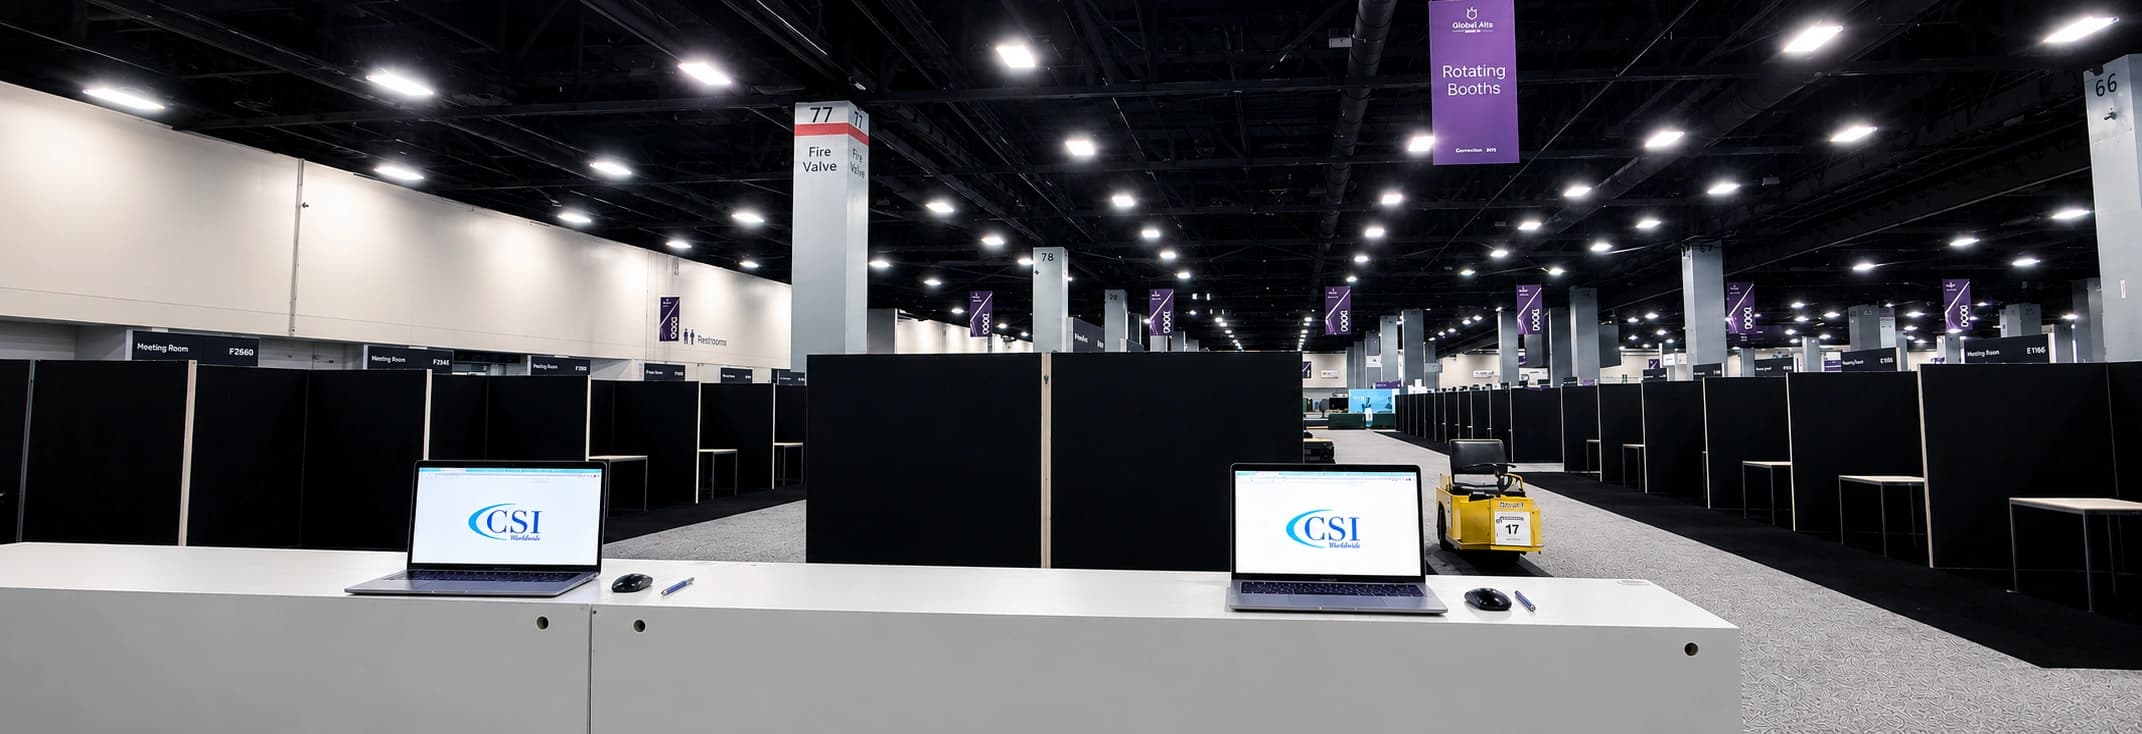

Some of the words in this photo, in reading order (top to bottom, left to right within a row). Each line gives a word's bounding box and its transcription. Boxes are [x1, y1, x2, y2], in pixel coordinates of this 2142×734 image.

[1442, 64, 1506, 79] Rotating
[1447, 82, 1501, 96] Booths
[2095, 72, 2117, 97] 66
[810, 106, 833, 123] 77
[854, 111, 863, 129] 77
[808, 146, 831, 157] Fire
[802, 161, 837, 172] Valve
[1041, 252, 1054, 262] 78
[697, 335, 727, 346] Restrooms
[136, 343, 167, 353] Meeting
[168, 344, 189, 353] Room
[486, 509, 543, 534] CSI
[1304, 516, 1360, 541] CSI
[1505, 524, 1519, 534] 17
